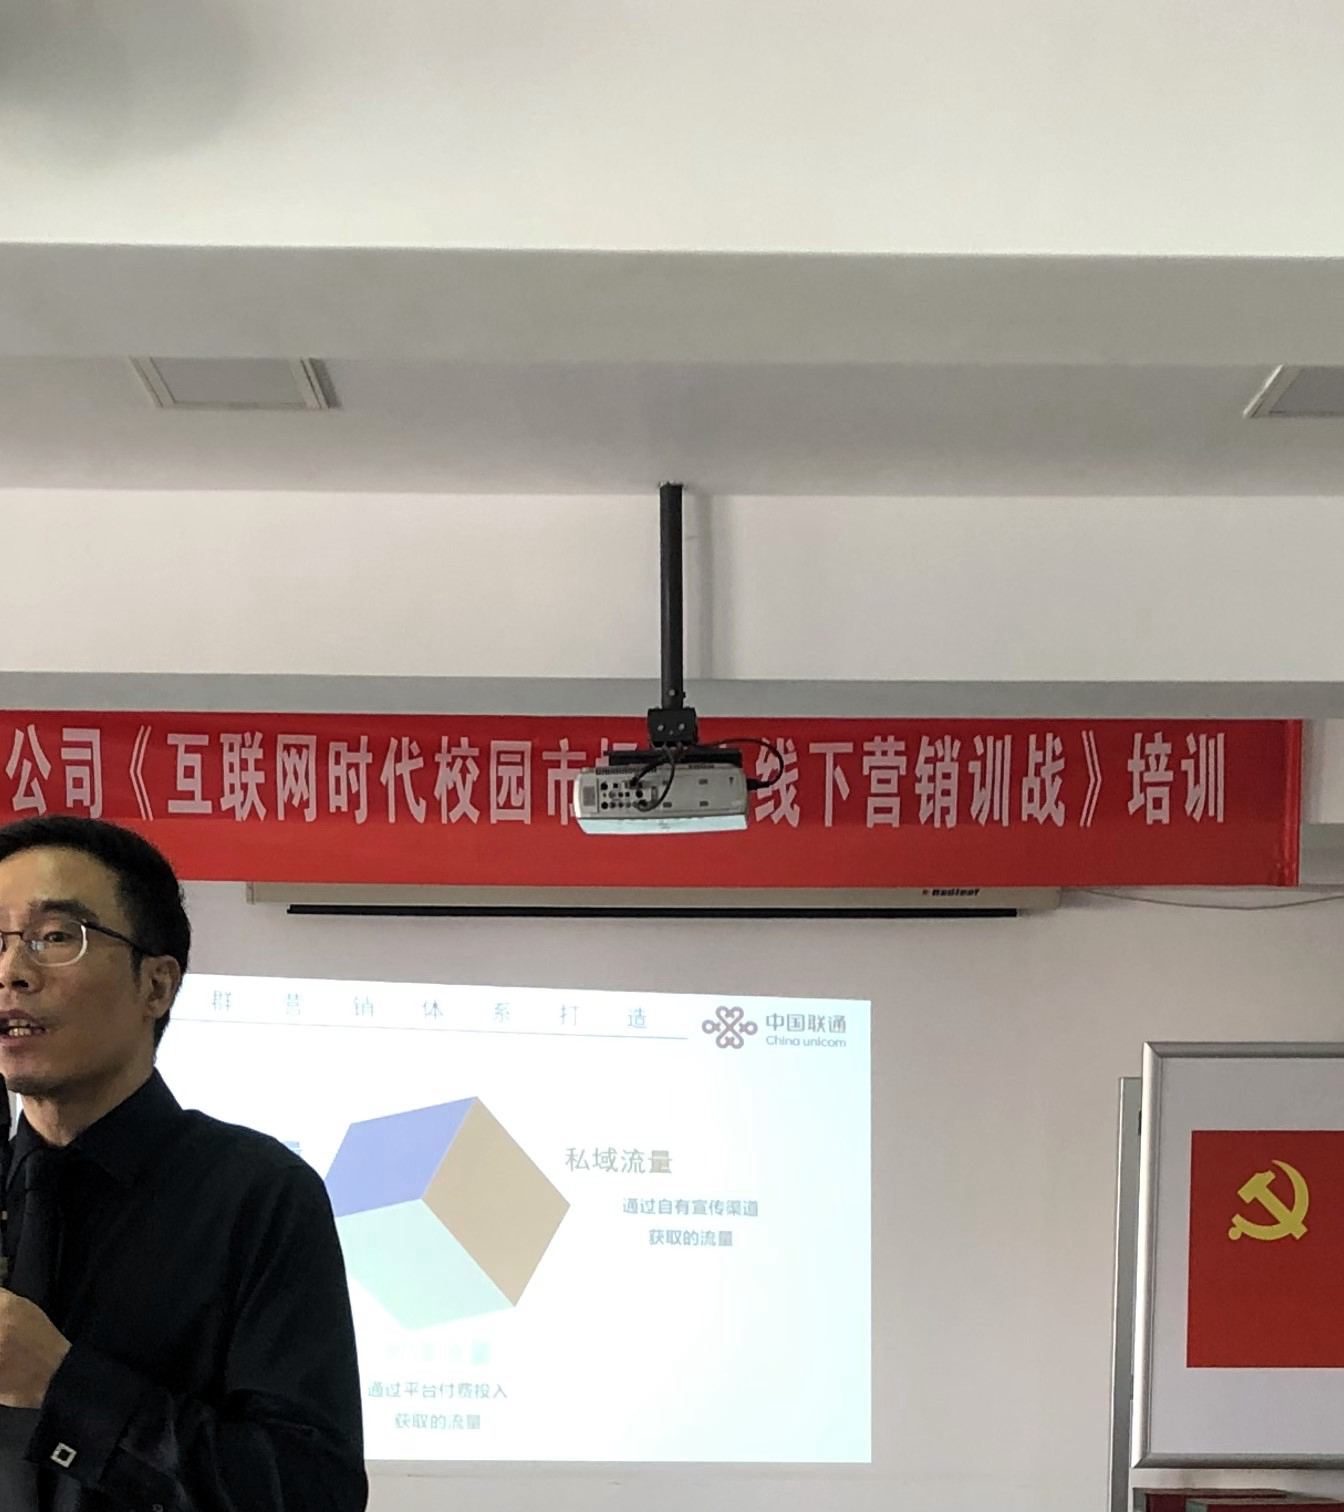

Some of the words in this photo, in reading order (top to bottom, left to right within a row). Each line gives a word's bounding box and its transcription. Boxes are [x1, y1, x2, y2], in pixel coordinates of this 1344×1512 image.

[765, 1011, 847, 1034] 中国联通
[765, 1034, 800, 1047] China
[564, 1146, 673, 1174] 私域流量
[622, 1197, 759, 1217] 通过自有宣传渠道
[648, 1228, 733, 1247] 获取的流量
[367, 1380, 508, 1399] 通过平台付费投入
[394, 1412, 481, 1430] 获取的流量
